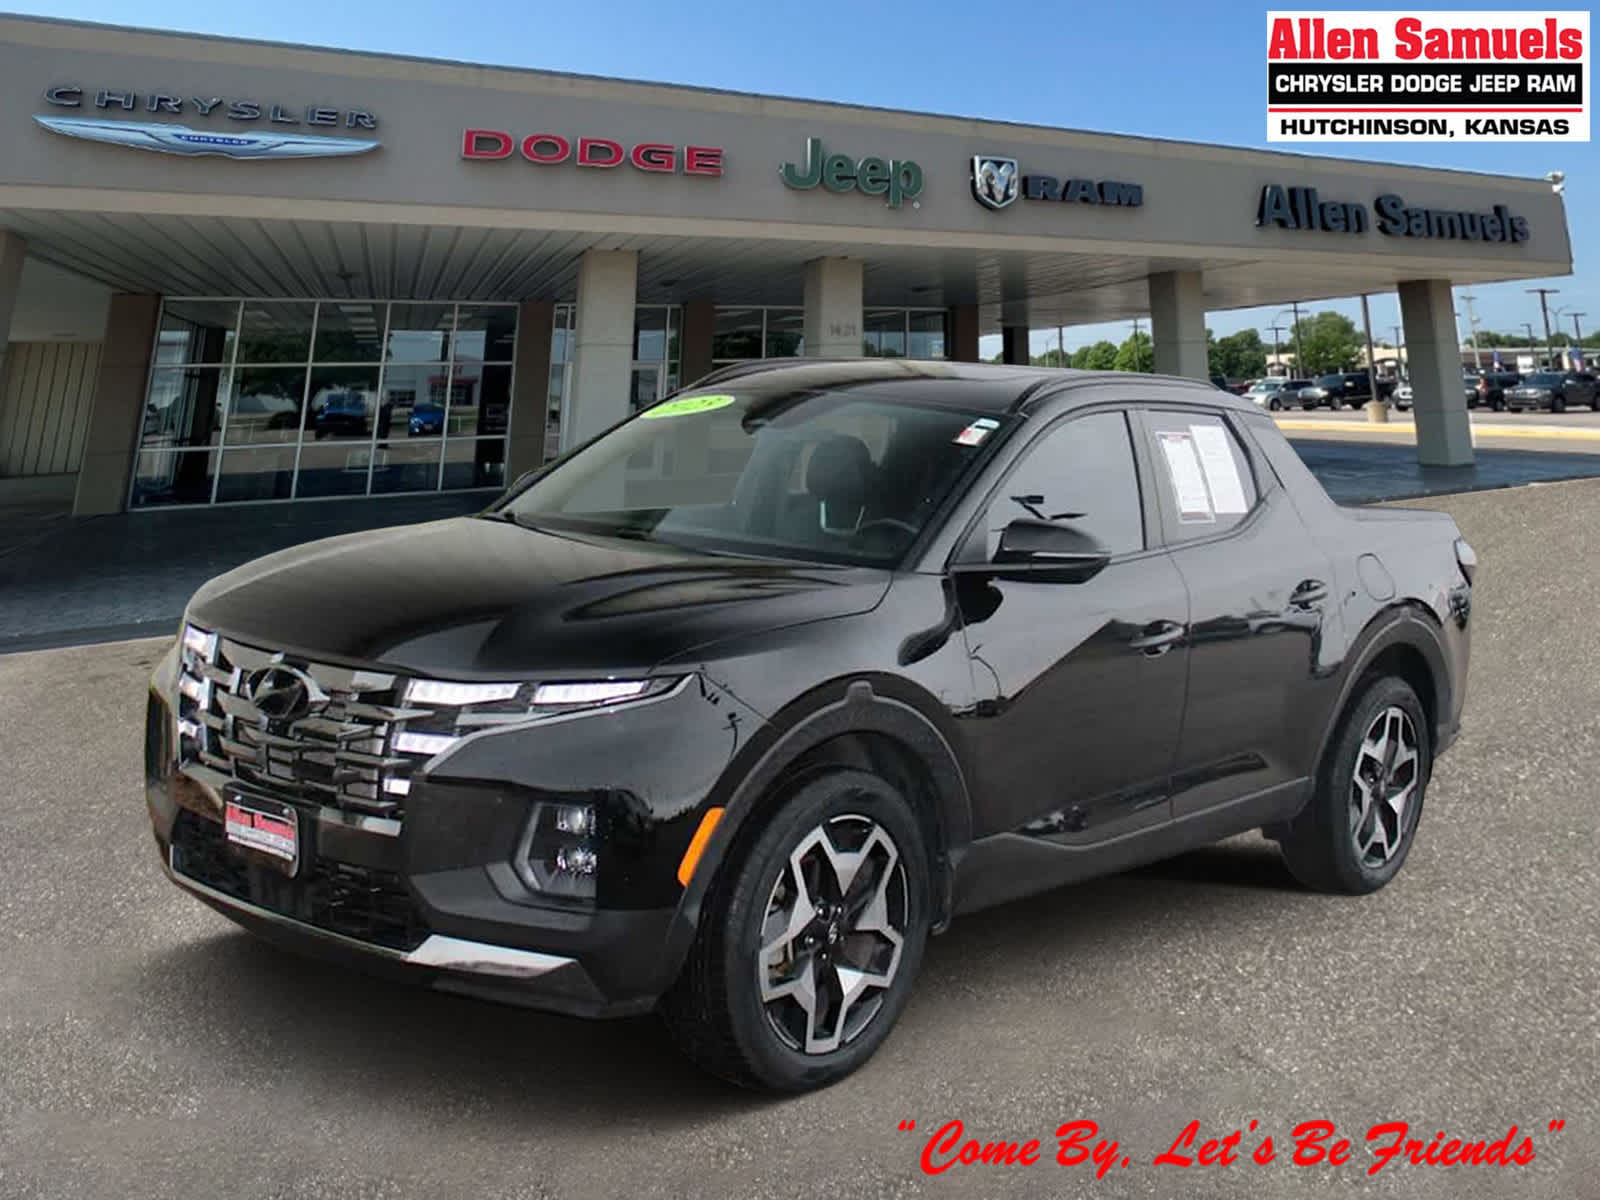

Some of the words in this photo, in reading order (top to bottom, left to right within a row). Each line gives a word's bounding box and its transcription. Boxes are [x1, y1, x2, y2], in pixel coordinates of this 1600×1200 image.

[44, 86, 378, 129] CHRYSLER
[462, 127, 725, 177] DODGE
[780, 137, 924, 209] Jeep
[1023, 174, 1144, 207] RAM
[1256, 184, 1369, 233] Allen
[1374, 193, 1531, 243] Samuels
